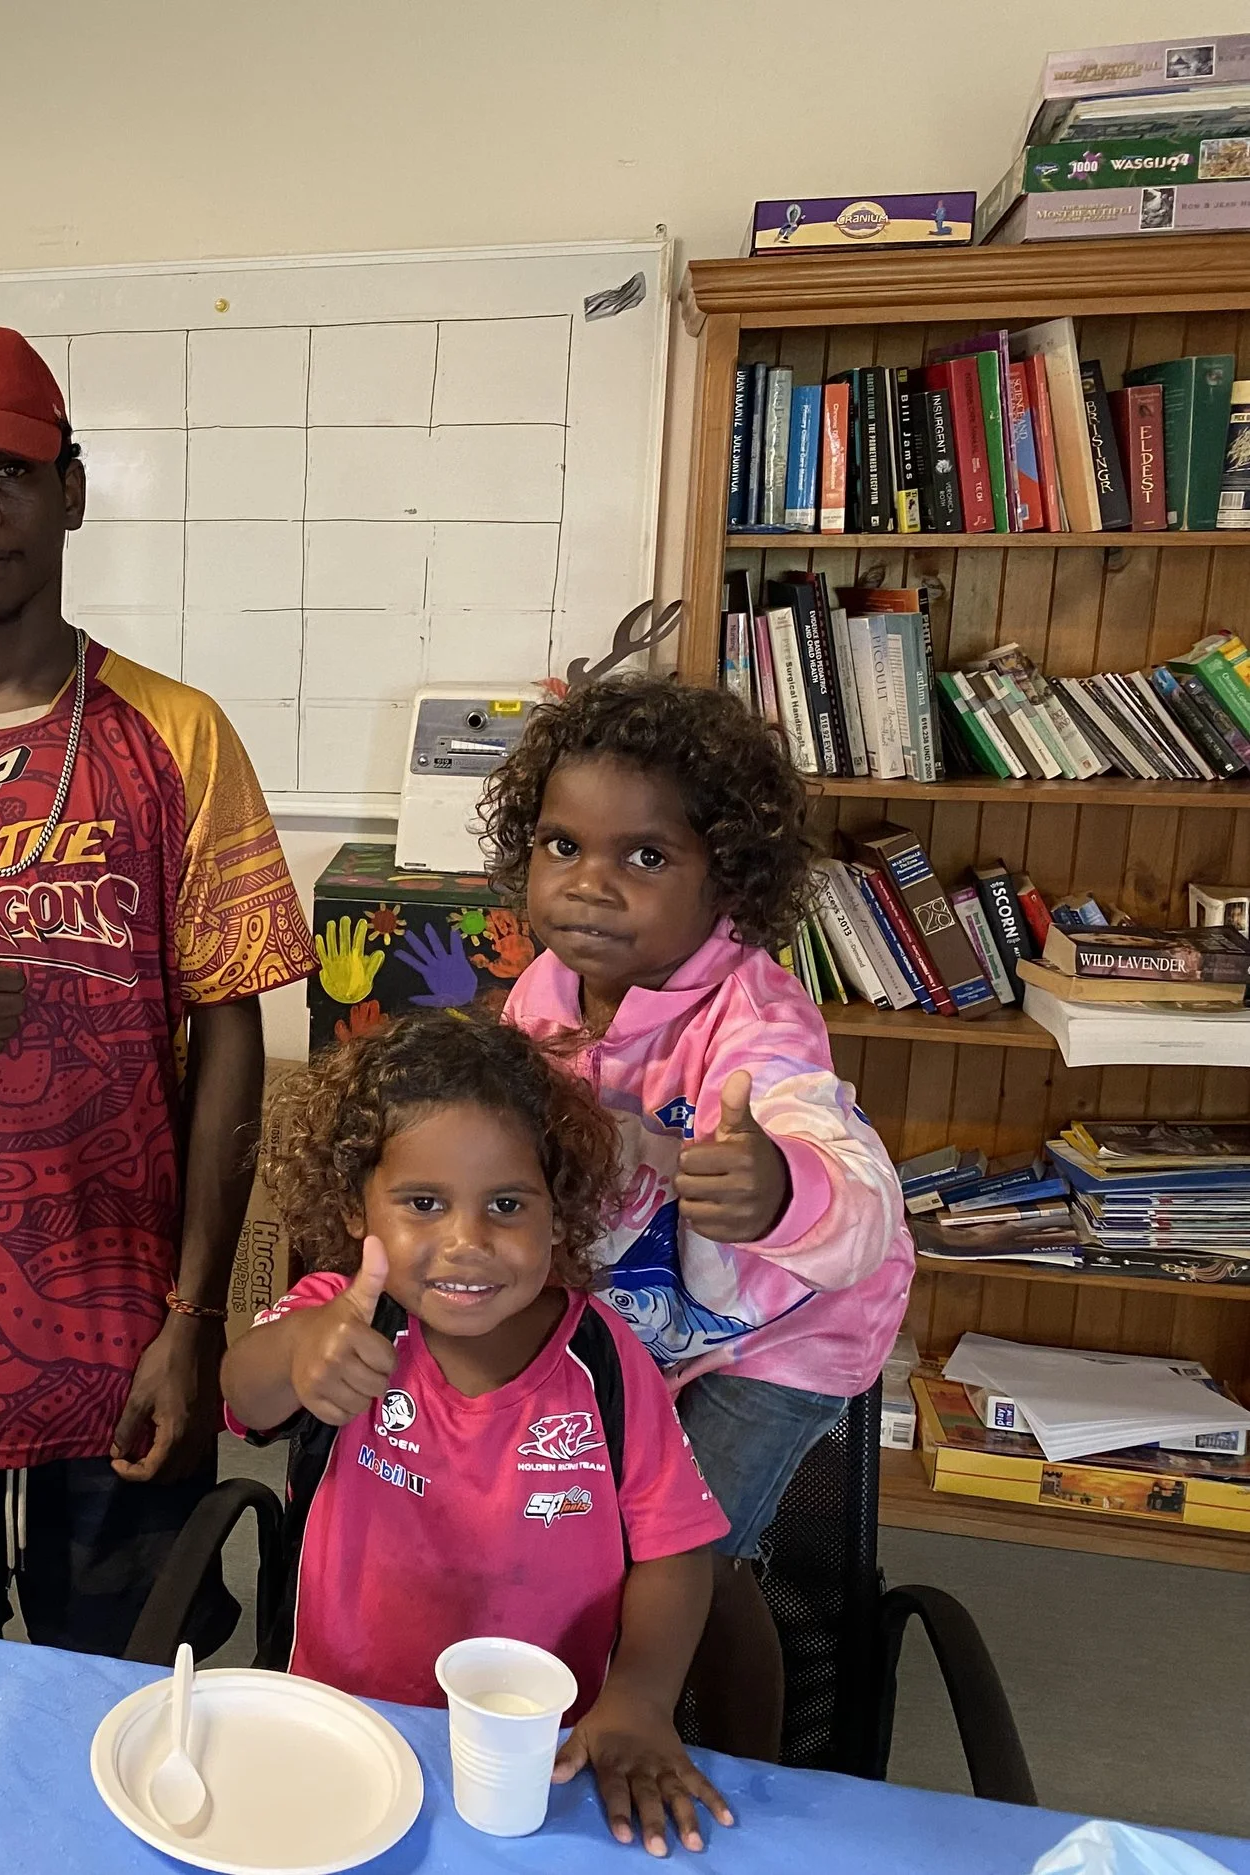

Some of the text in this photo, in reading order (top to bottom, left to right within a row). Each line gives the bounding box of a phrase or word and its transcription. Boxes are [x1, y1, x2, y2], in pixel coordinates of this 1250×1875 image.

[1071, 160, 1098, 173] 1000
[901, 394, 909, 422] Bill
[932, 394, 946, 454] INSURGENT
[902, 432, 913, 480] James
[1086, 401, 1114, 494] BRISINGR
[1140, 425, 1154, 504] ELDEST
[785, 661, 798, 702] Surgical
[871, 635, 888, 702] PICOULT
[915, 670, 930, 706] asthma
[837, 915, 853, 937] 2013
[916, 900, 953, 934] 28
[992, 887, 1019, 939] SCORN
[1079, 952, 1115, 968] WILD
[1117, 955, 1189, 973] LAVENDER
[250, 1220, 279, 1318] HUGGIES
[995, 1408, 1006, 1426] play
[358, 1444, 406, 1488] Mobil
[517, 1463, 556, 1472] HOLDEN
[579, 1461, 606, 1472] TEAM
